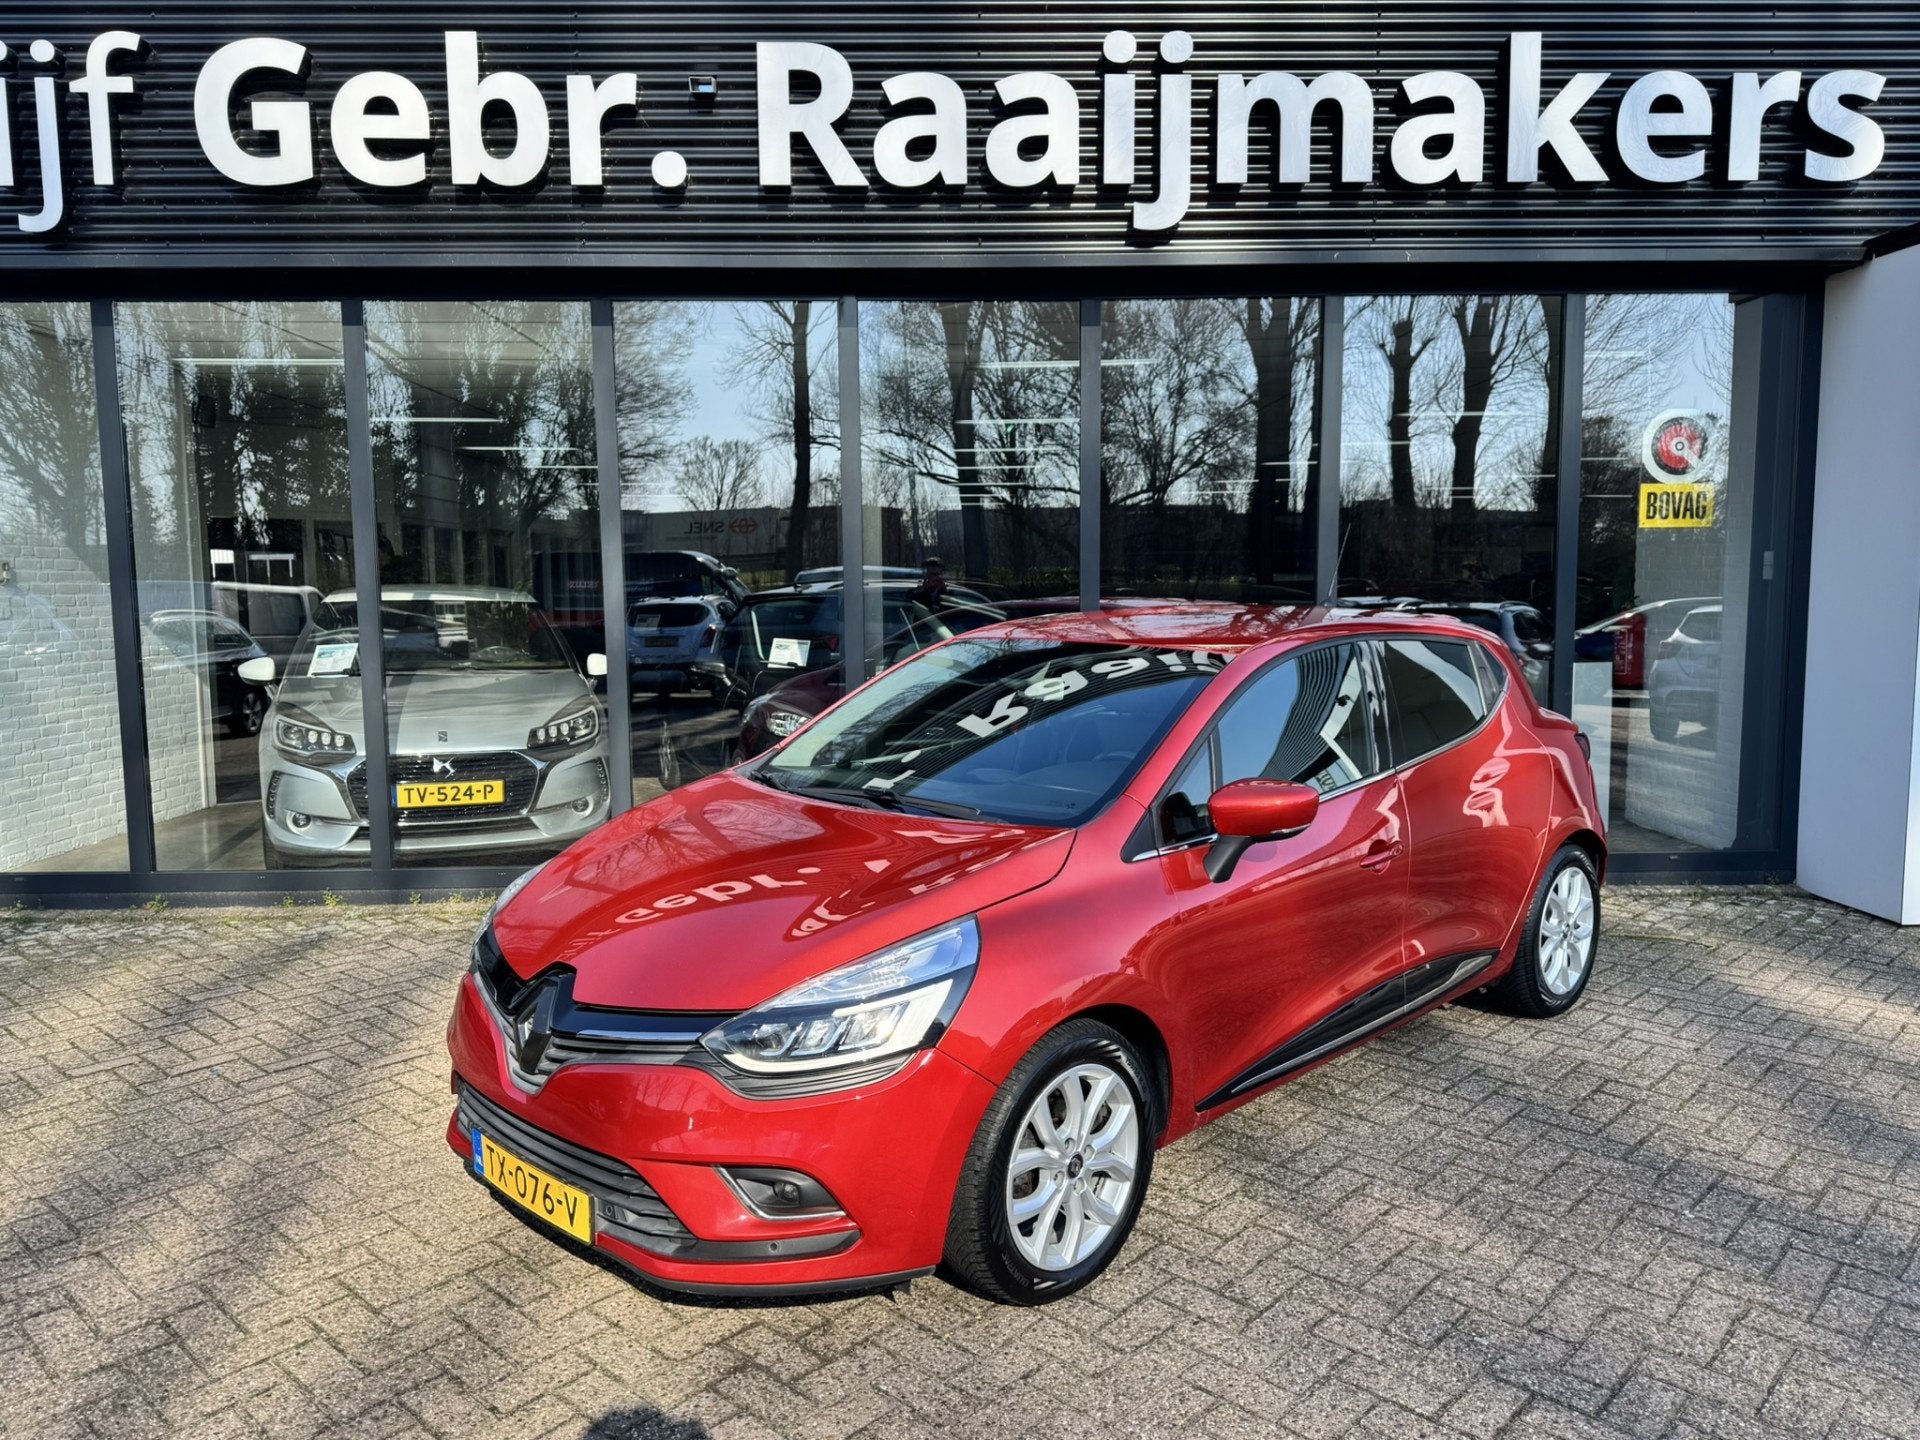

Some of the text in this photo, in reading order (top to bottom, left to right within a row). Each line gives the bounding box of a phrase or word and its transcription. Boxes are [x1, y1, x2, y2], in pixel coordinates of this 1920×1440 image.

[195, 31, 688, 188] Gebr.
[755, 30, 1886, 230] Raaijmakers
[1646, 490, 1708, 520] BOVAG
[404, 784, 494, 804] TV-524-P
[486, 1143, 578, 1228] TX-076-V
